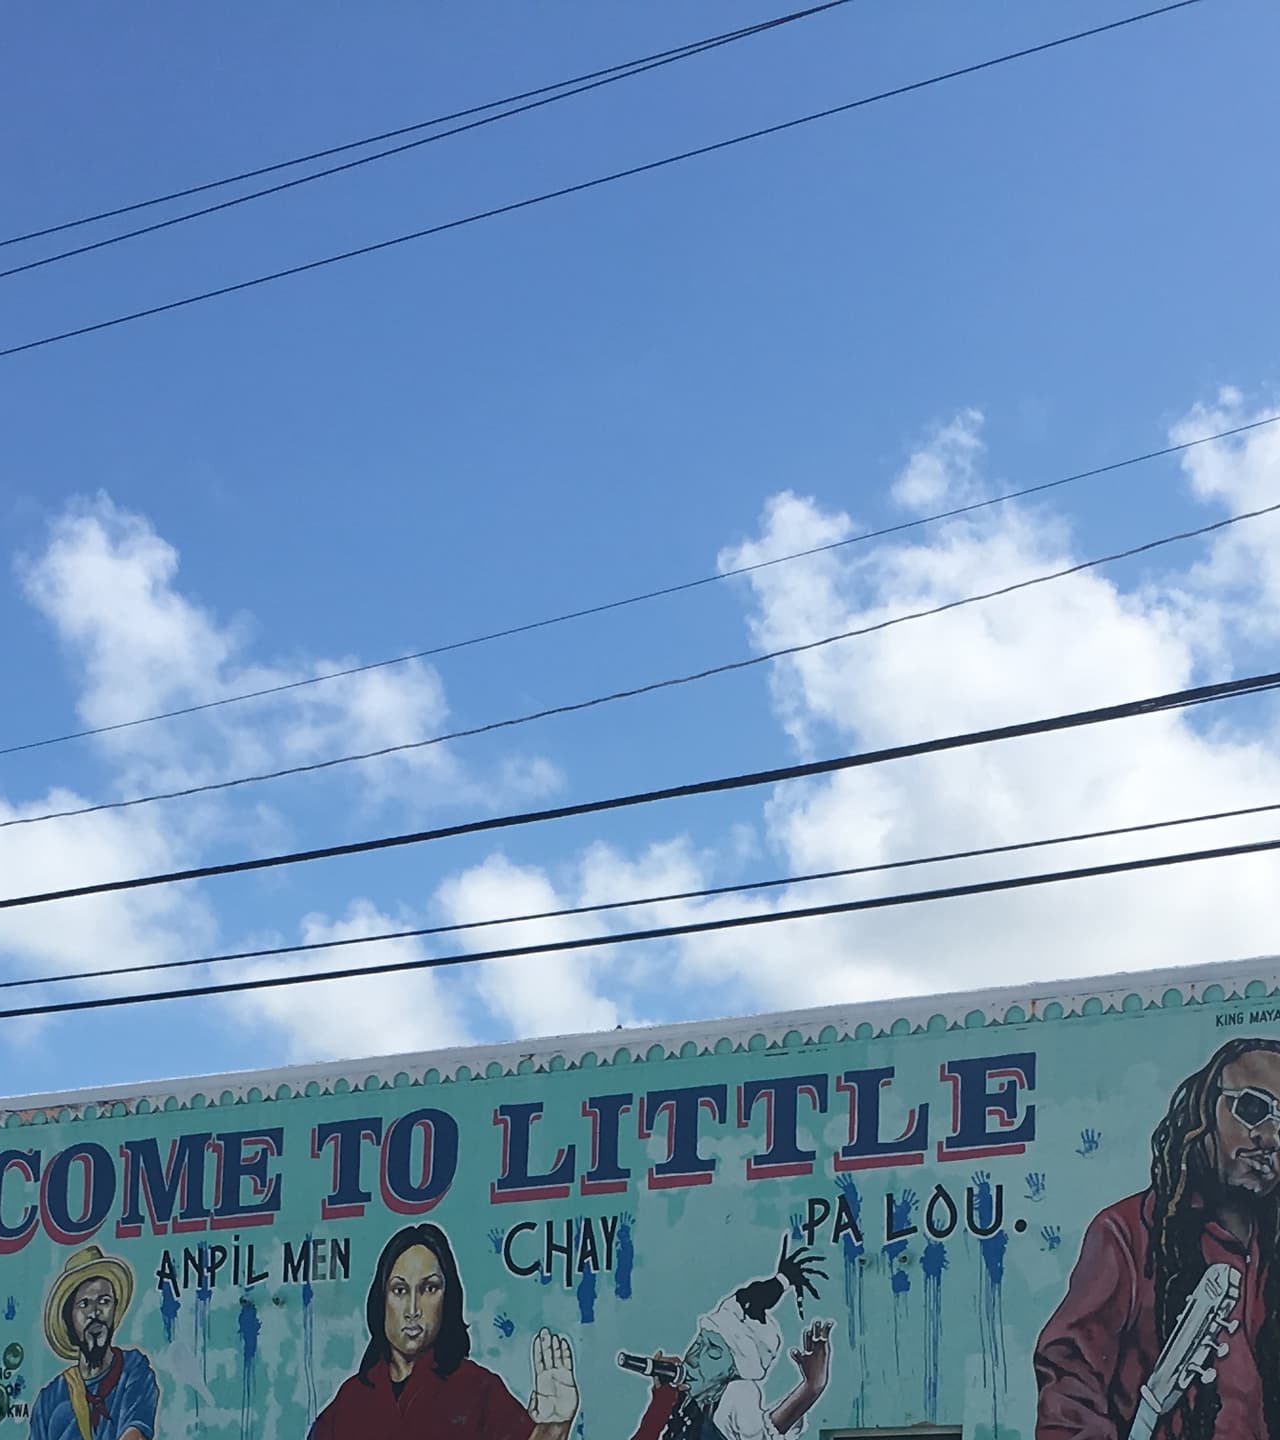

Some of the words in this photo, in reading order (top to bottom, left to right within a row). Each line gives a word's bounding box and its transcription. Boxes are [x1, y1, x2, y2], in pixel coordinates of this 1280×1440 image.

[1216, 1012, 1244, 1027] KING
[312, 1107, 460, 1219] TO
[489, 1051, 1038, 1205] LITTLE
[283, 1238, 351, 1284] MEN
[503, 1215, 619, 1288] CHAY
[802, 1194, 864, 1247] PA
